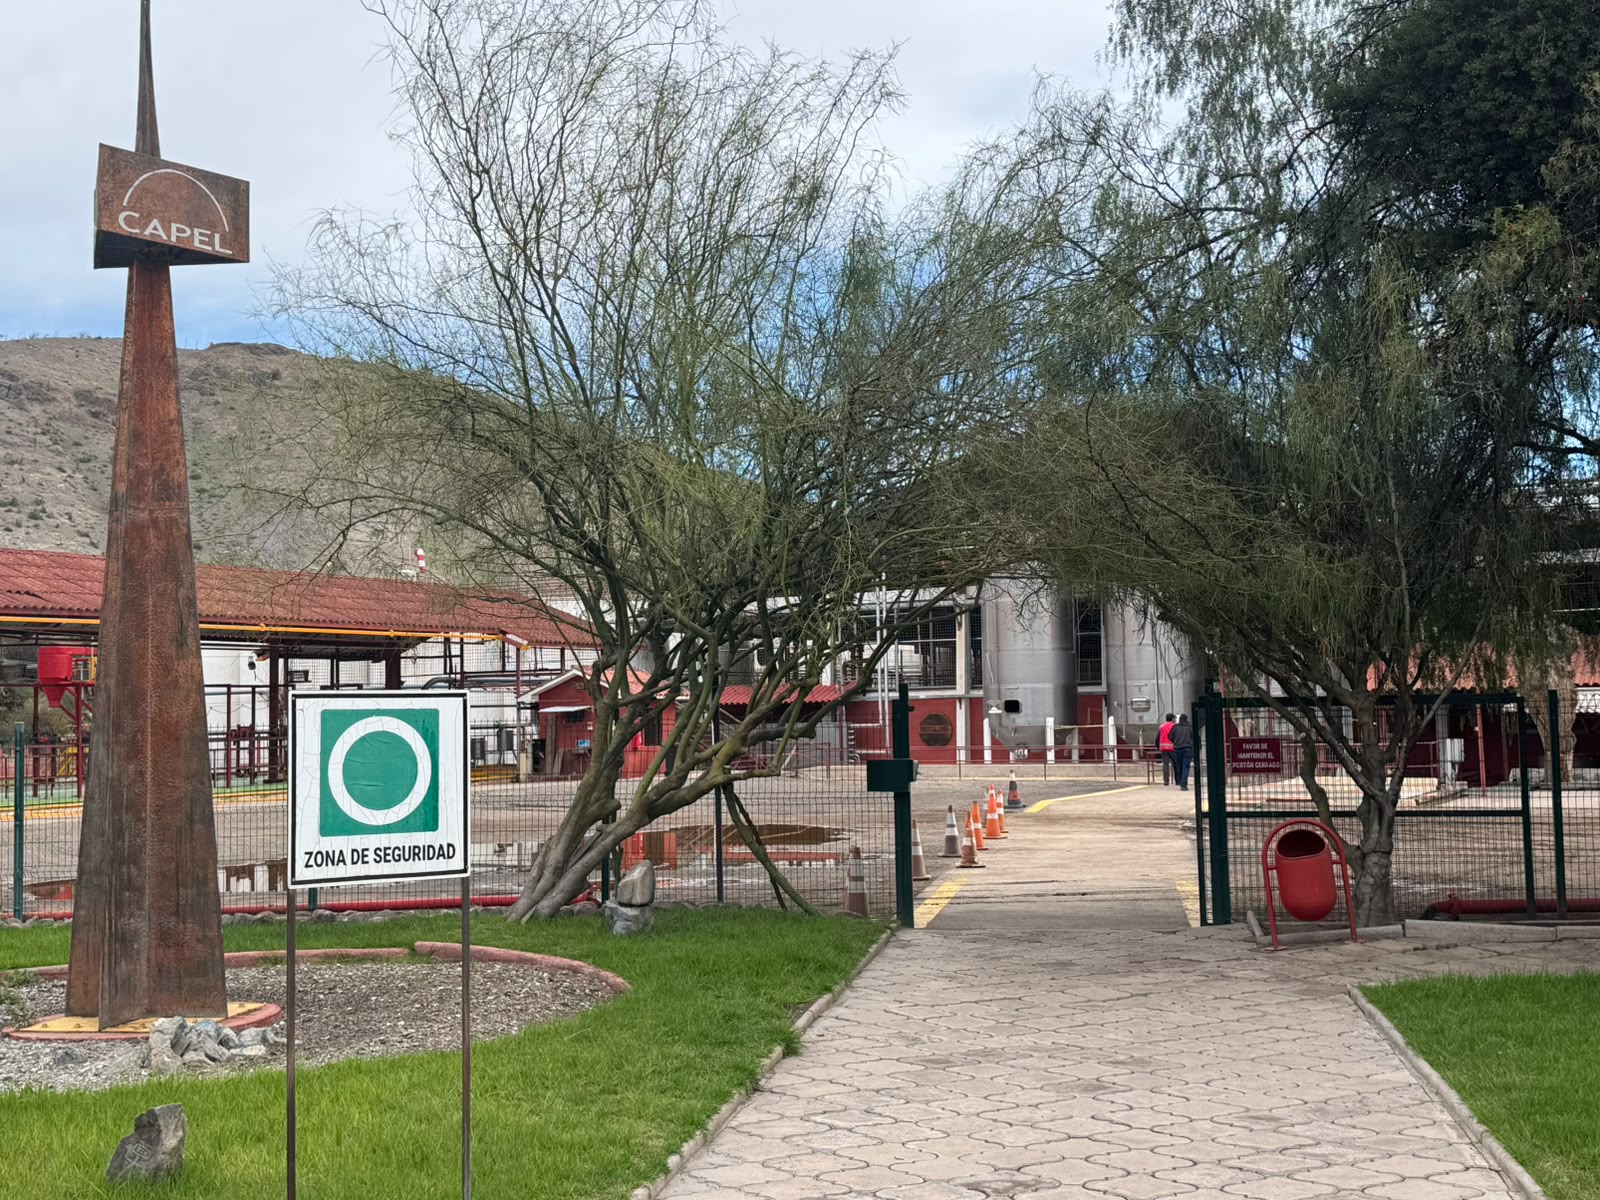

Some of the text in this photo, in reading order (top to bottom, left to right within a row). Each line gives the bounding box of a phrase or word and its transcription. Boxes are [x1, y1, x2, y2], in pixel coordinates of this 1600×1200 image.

[118, 211, 232, 254] CAPEL
[304, 843, 456, 868] ZONA DE SEGURIDAD
